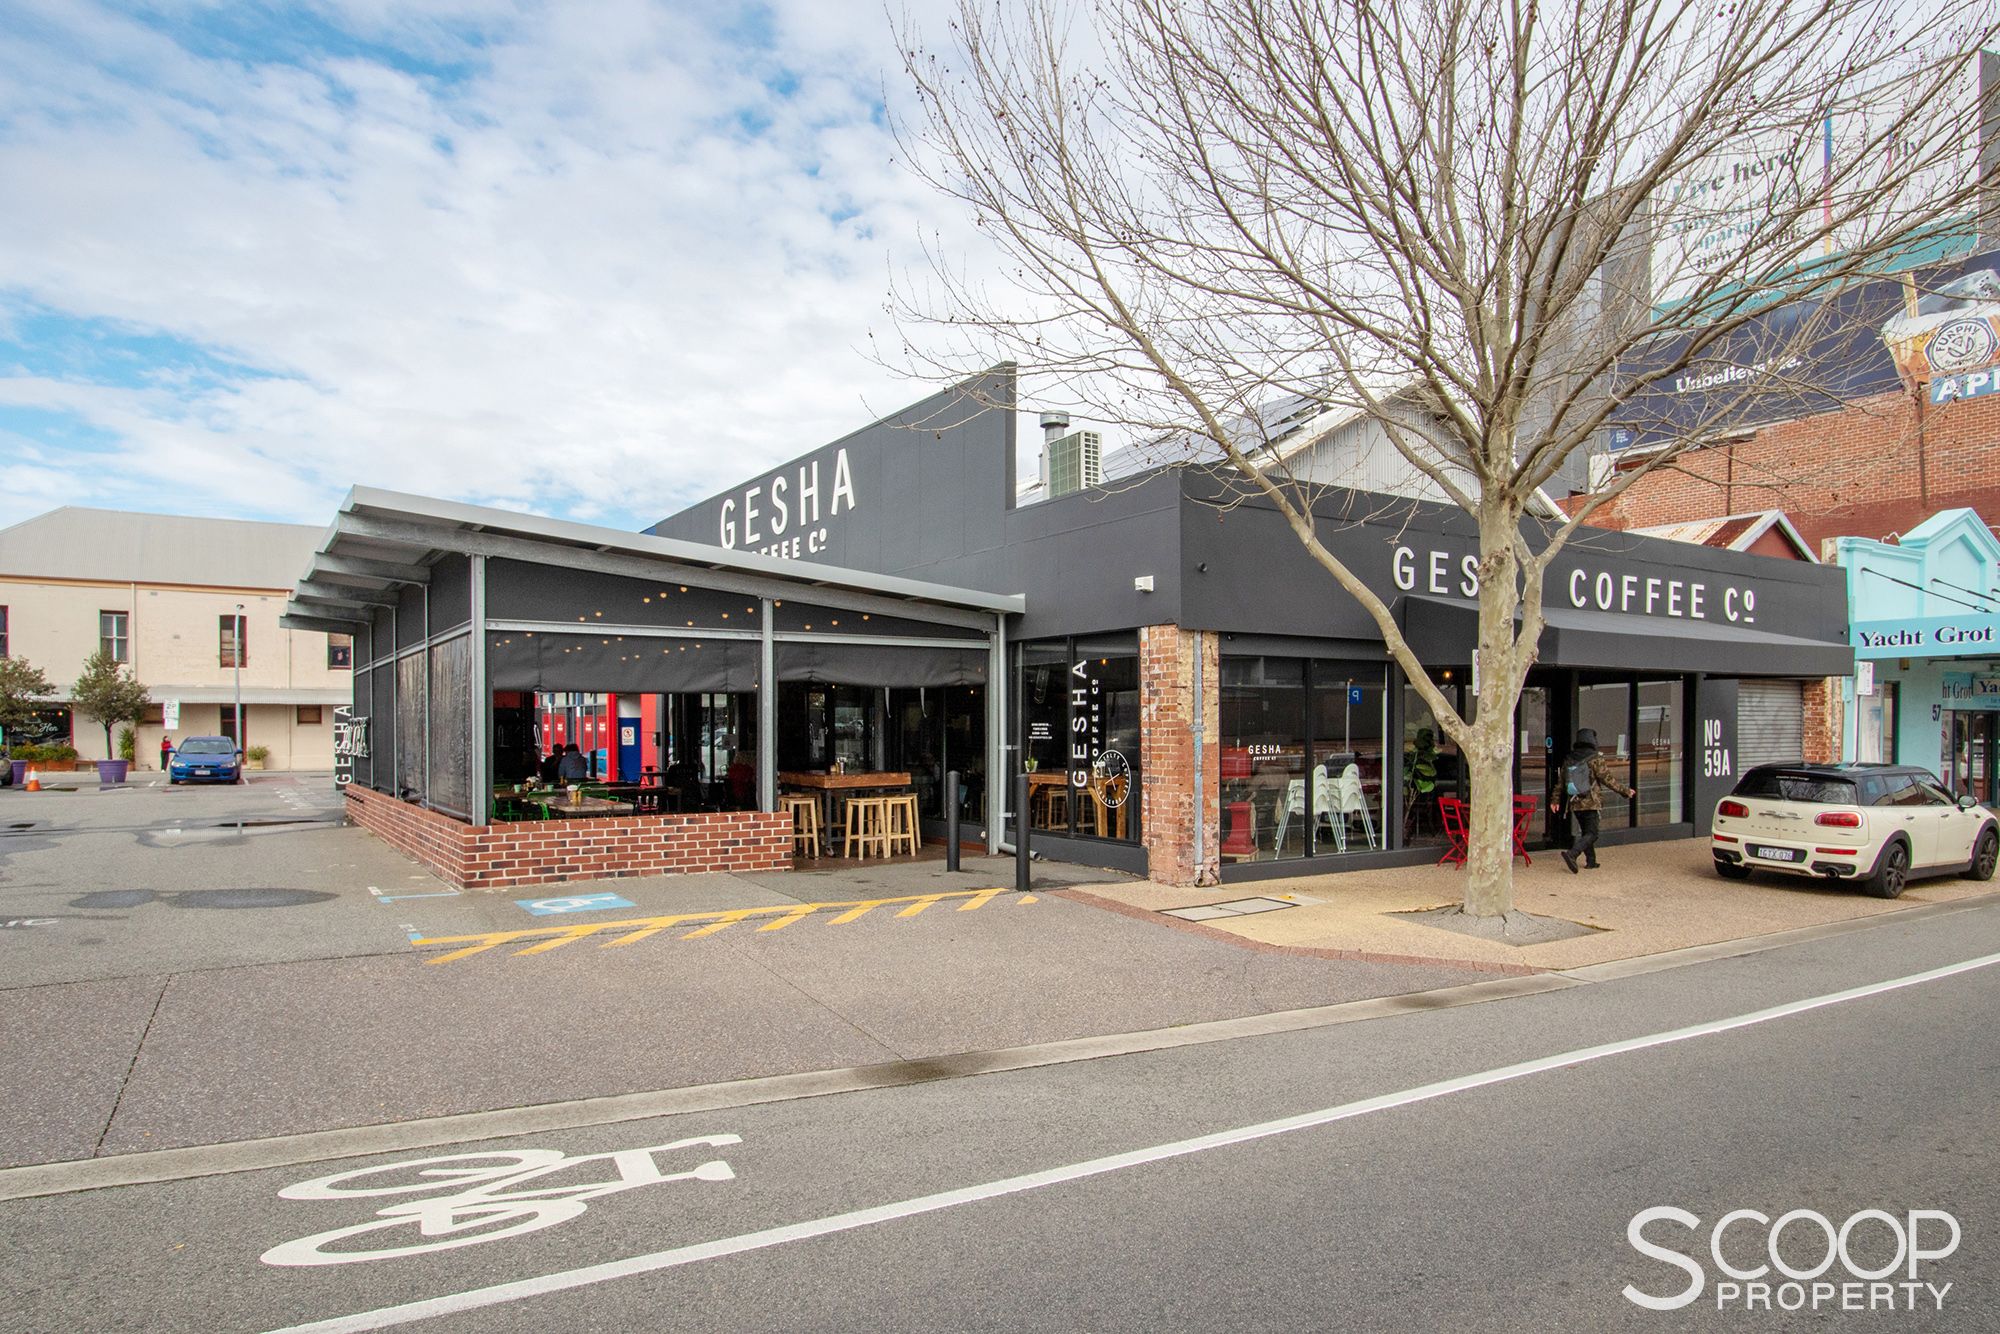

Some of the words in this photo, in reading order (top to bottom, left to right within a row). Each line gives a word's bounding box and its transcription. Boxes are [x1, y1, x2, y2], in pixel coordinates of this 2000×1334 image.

[1935, 324, 1981, 353] FURPHY
[720, 448, 856, 550] GESHA
[1392, 546, 1480, 598] GES
[1569, 569, 1705, 619] COFFEE
[1859, 630, 1925, 648] Yacht
[1934, 625, 1996, 644] Grot
[1072, 660, 1087, 788] GESHA
[1091, 703, 1099, 768] COFFEE
[1932, 704, 1942, 722] 57
[334, 705, 352, 785] GESHA
[1248, 744, 1281, 755] GESHA
[1704, 749, 1730, 777] 59A
